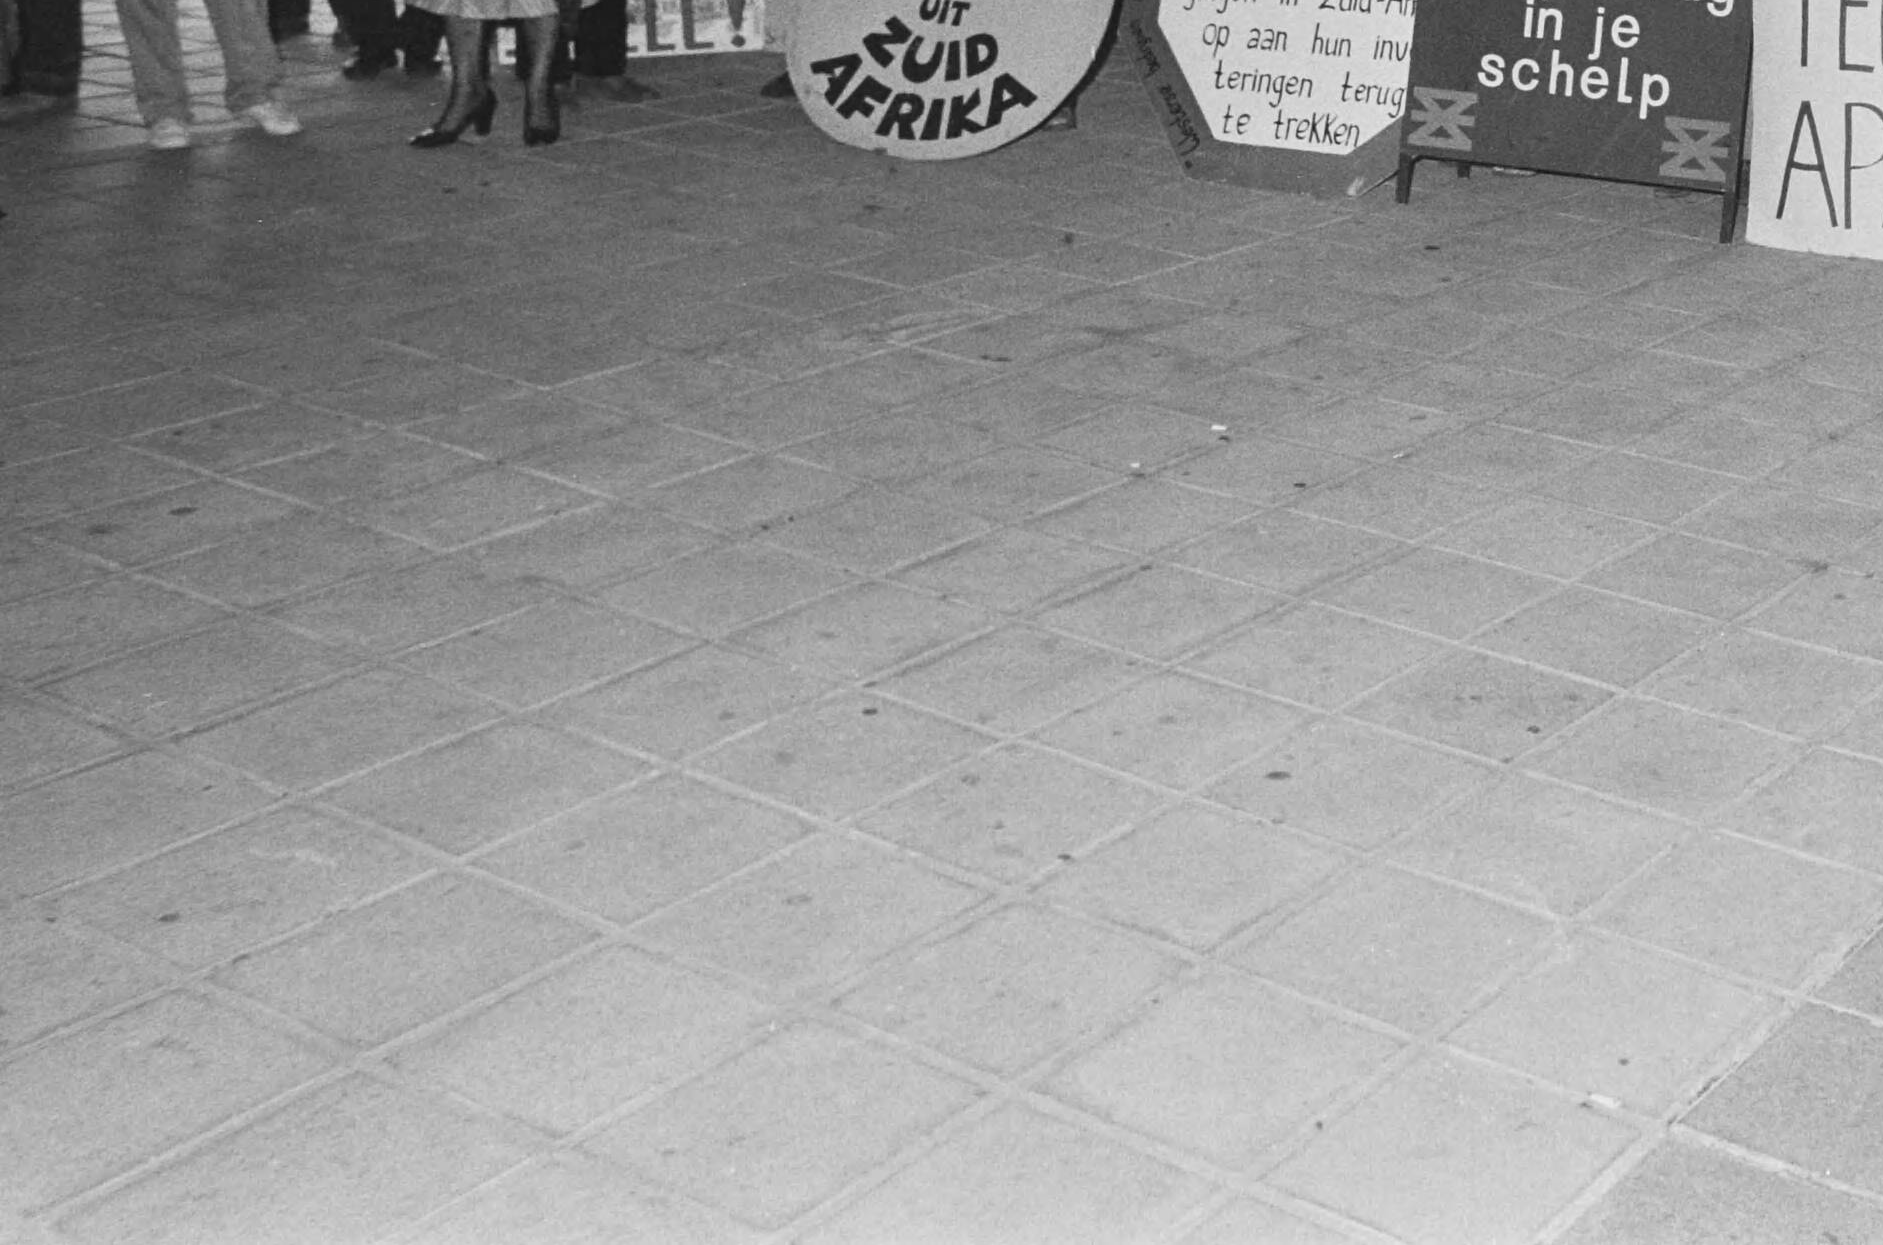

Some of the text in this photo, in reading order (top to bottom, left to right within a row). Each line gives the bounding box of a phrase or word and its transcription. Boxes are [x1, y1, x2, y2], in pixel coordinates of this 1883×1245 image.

[862, 16, 999, 84] ZUID
[1202, 22, 1410, 62] op aan hun inv
[1588, 6, 1641, 61] je
[810, 53, 1038, 141] AFRIKA
[1214, 59, 1406, 119] teringen terug
[1477, 49, 1671, 120] schelp
[1223, 104, 1251, 136] te
